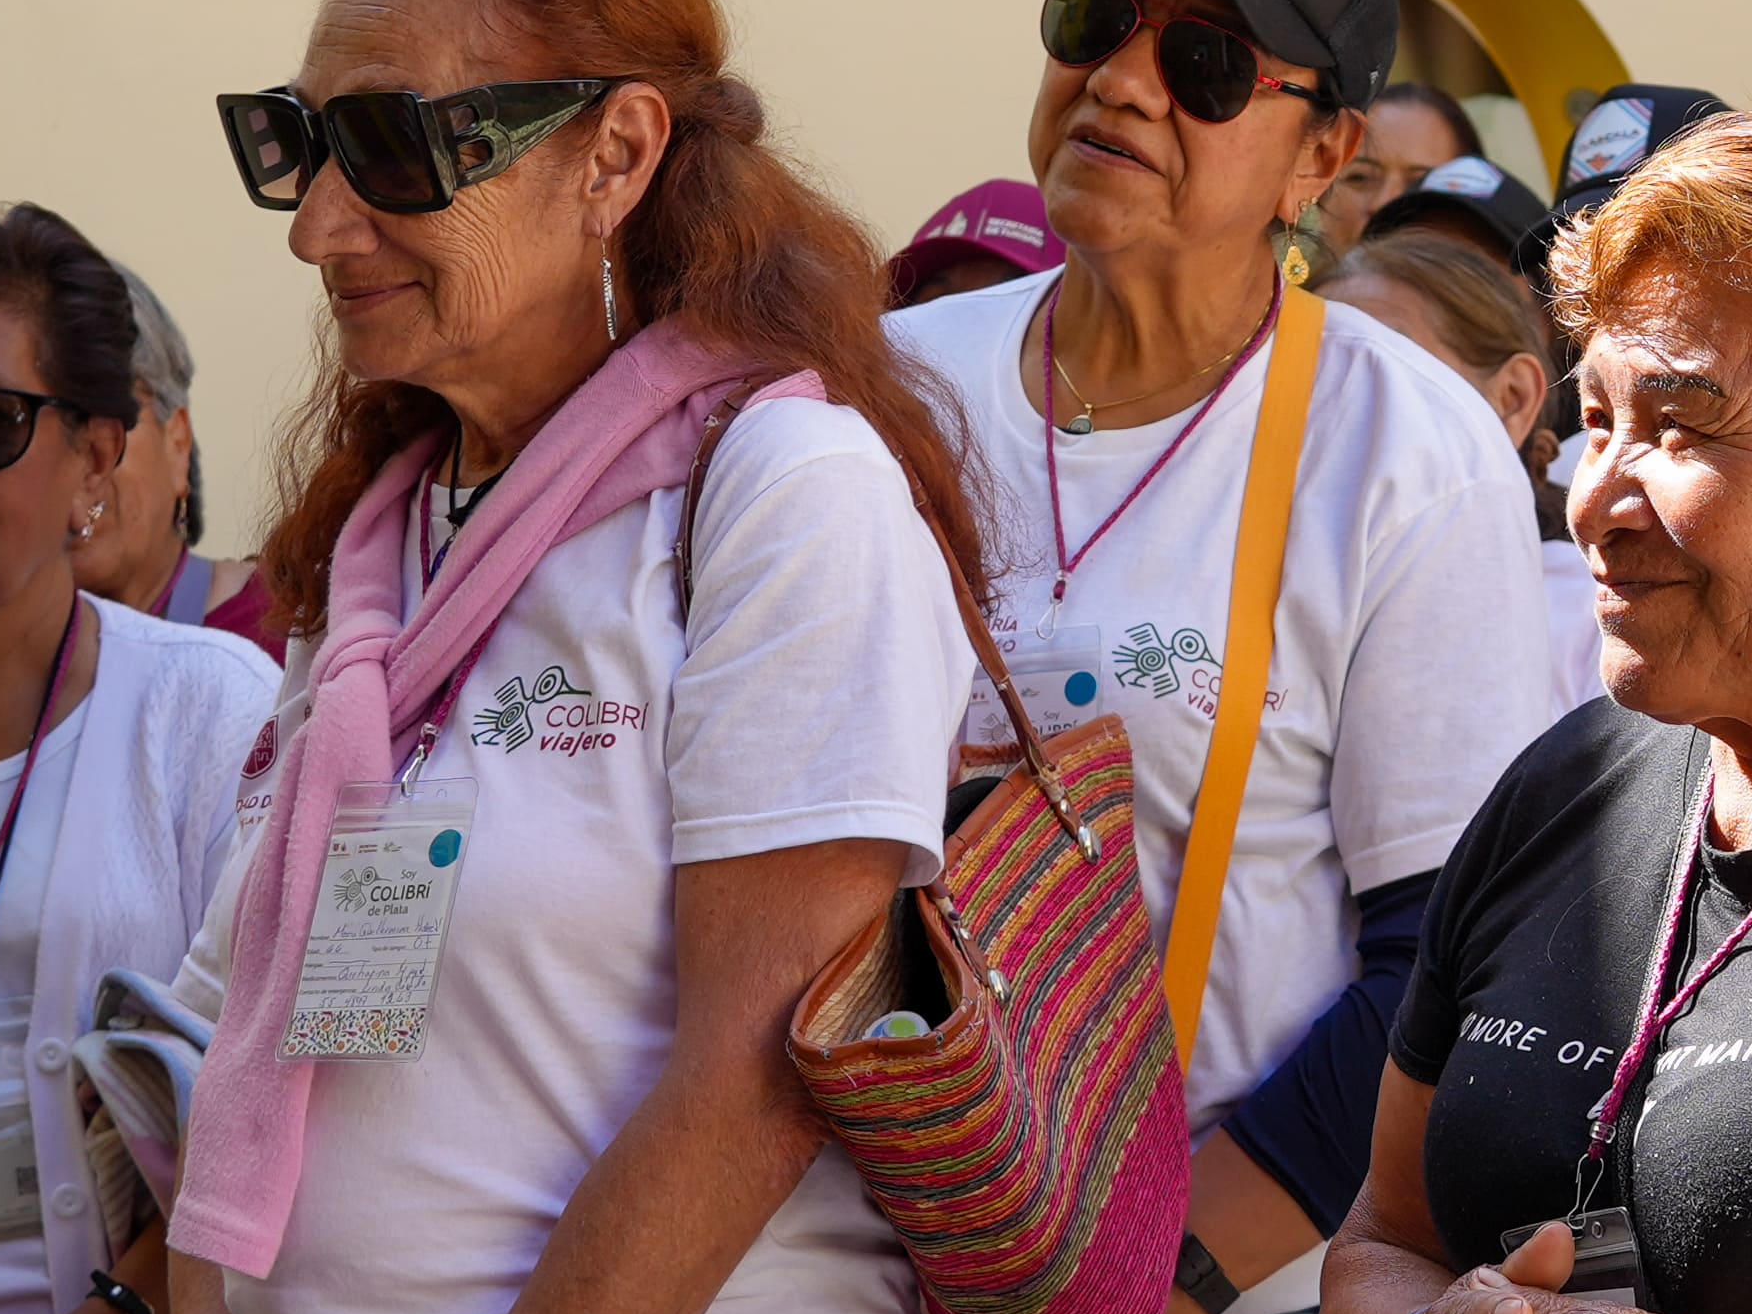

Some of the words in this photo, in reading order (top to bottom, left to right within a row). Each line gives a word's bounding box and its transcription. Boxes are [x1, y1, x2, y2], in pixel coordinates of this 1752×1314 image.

[546, 701, 649, 731] COLIBRÍ
[540, 731, 616, 757] viajero
[401, 869, 417, 880] Soy
[370, 880, 433, 902] COLIBRÍ
[368, 906, 380, 916] de
[383, 904, 408, 916] Plata
[1467, 1016, 1547, 1052] MORE
[1557, 1040, 1614, 1071] OF
